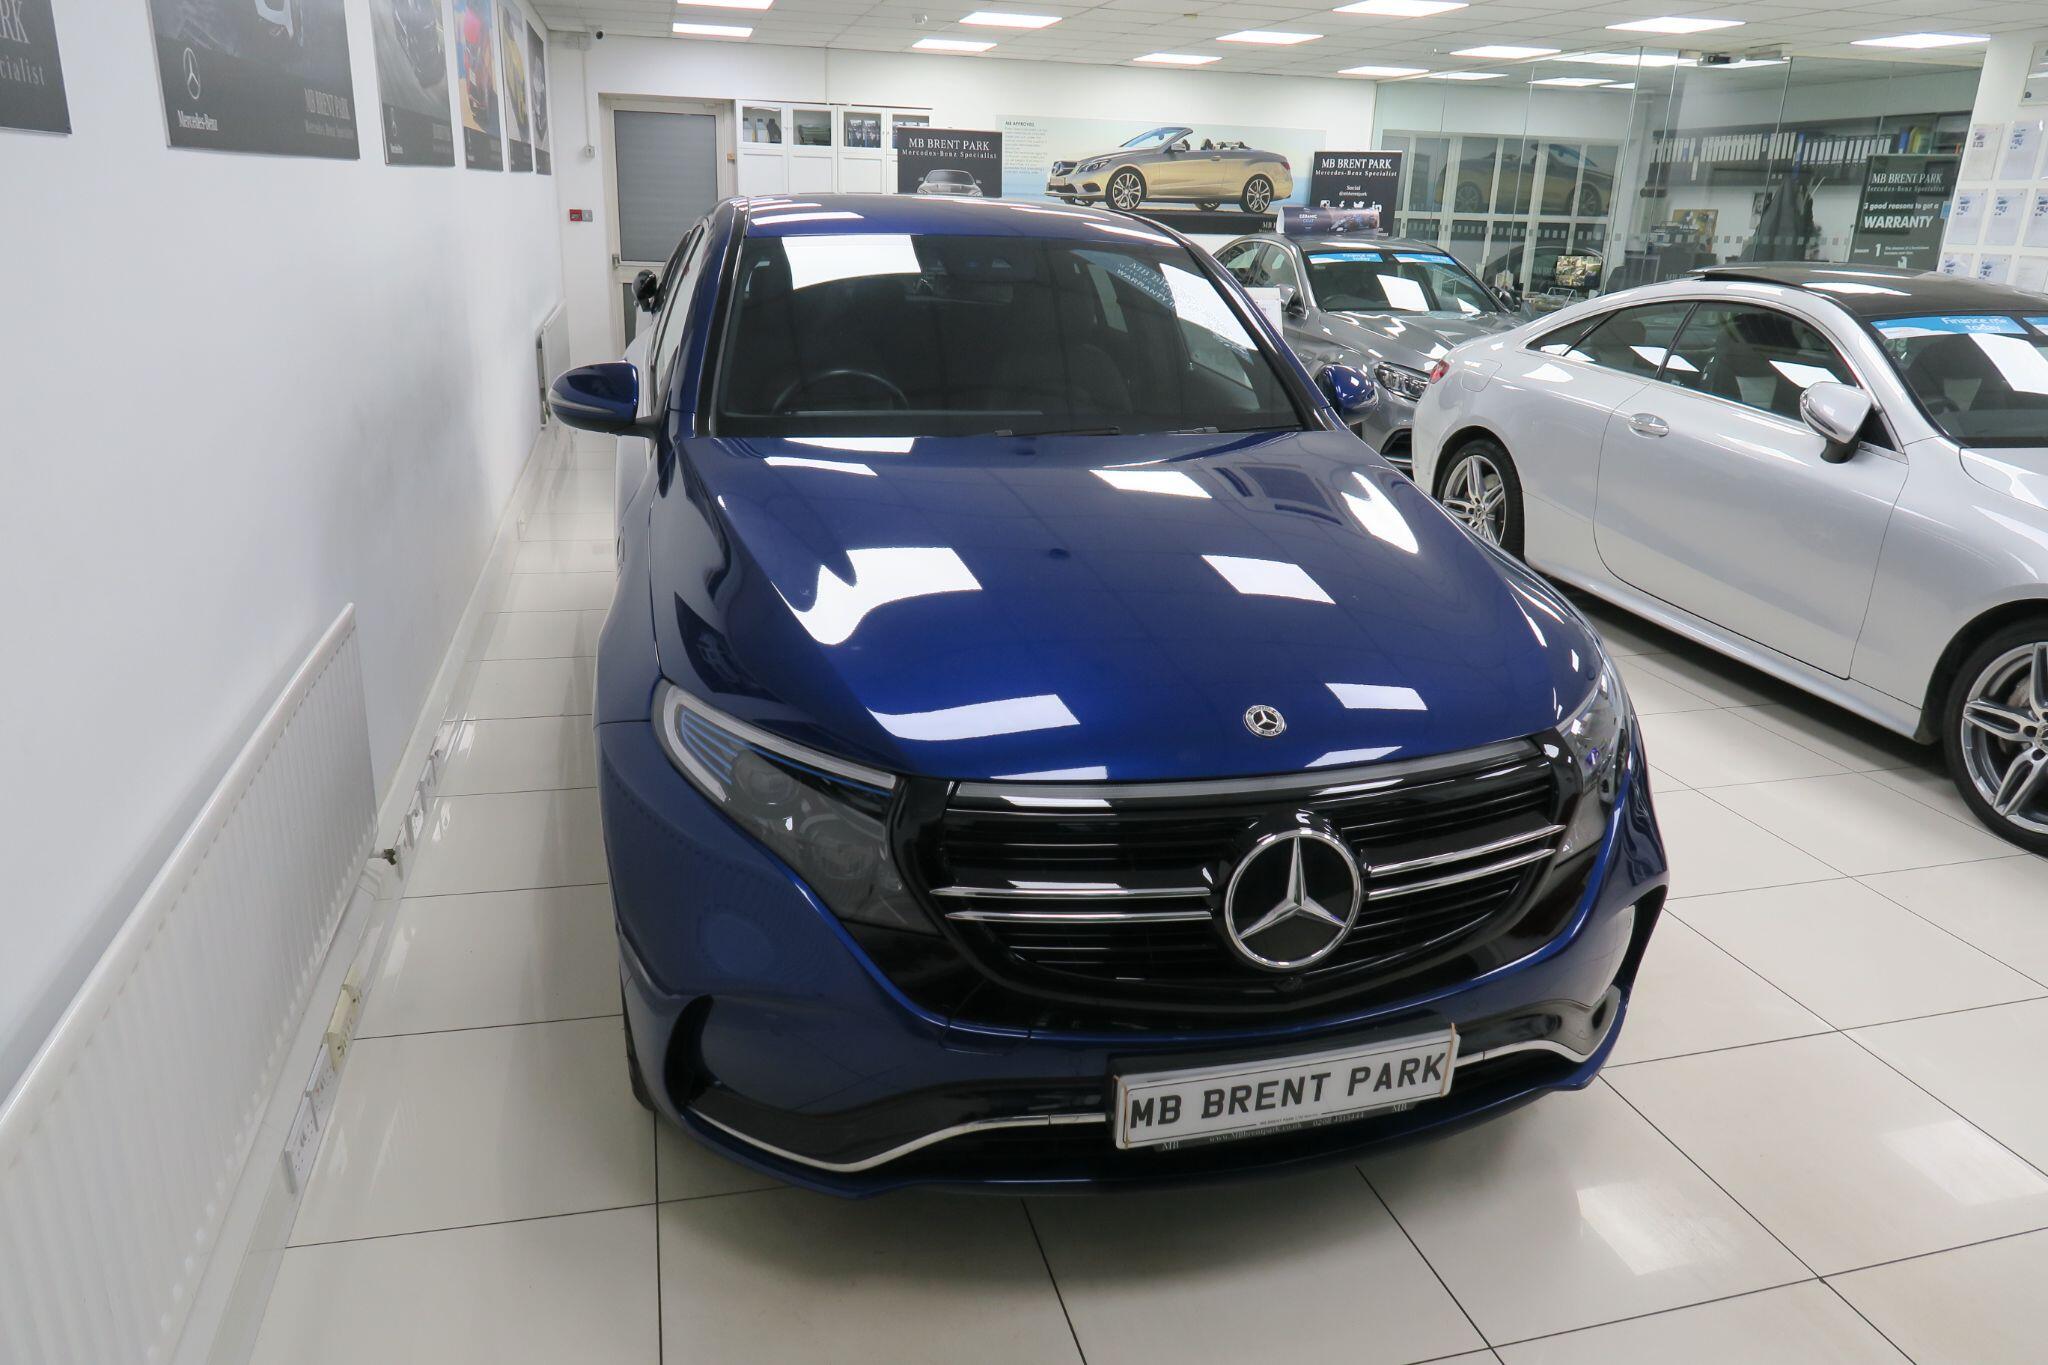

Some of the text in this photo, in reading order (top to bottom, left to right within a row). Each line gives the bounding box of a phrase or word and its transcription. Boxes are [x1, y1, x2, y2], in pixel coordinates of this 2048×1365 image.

[908, 138, 990, 151] MB BRENT PARK
[960, 151, 997, 159] Specialist
[1321, 158, 1392, 169] MB BRENT PARK
[1364, 170, 1397, 178] Specialist
[1872, 173, 1943, 184] MB BRENT PARK
[1869, 202, 1888, 212] good
[1922, 202, 1934, 211] get
[1864, 215, 1934, 229] WARRANTY
[1117, 269, 1169, 302] WARRANTY
[1941, 317, 1989, 325] Finance
[1965, 324, 2000, 332] today
[1131, 1052, 1446, 1129] MB BRENT PARK
